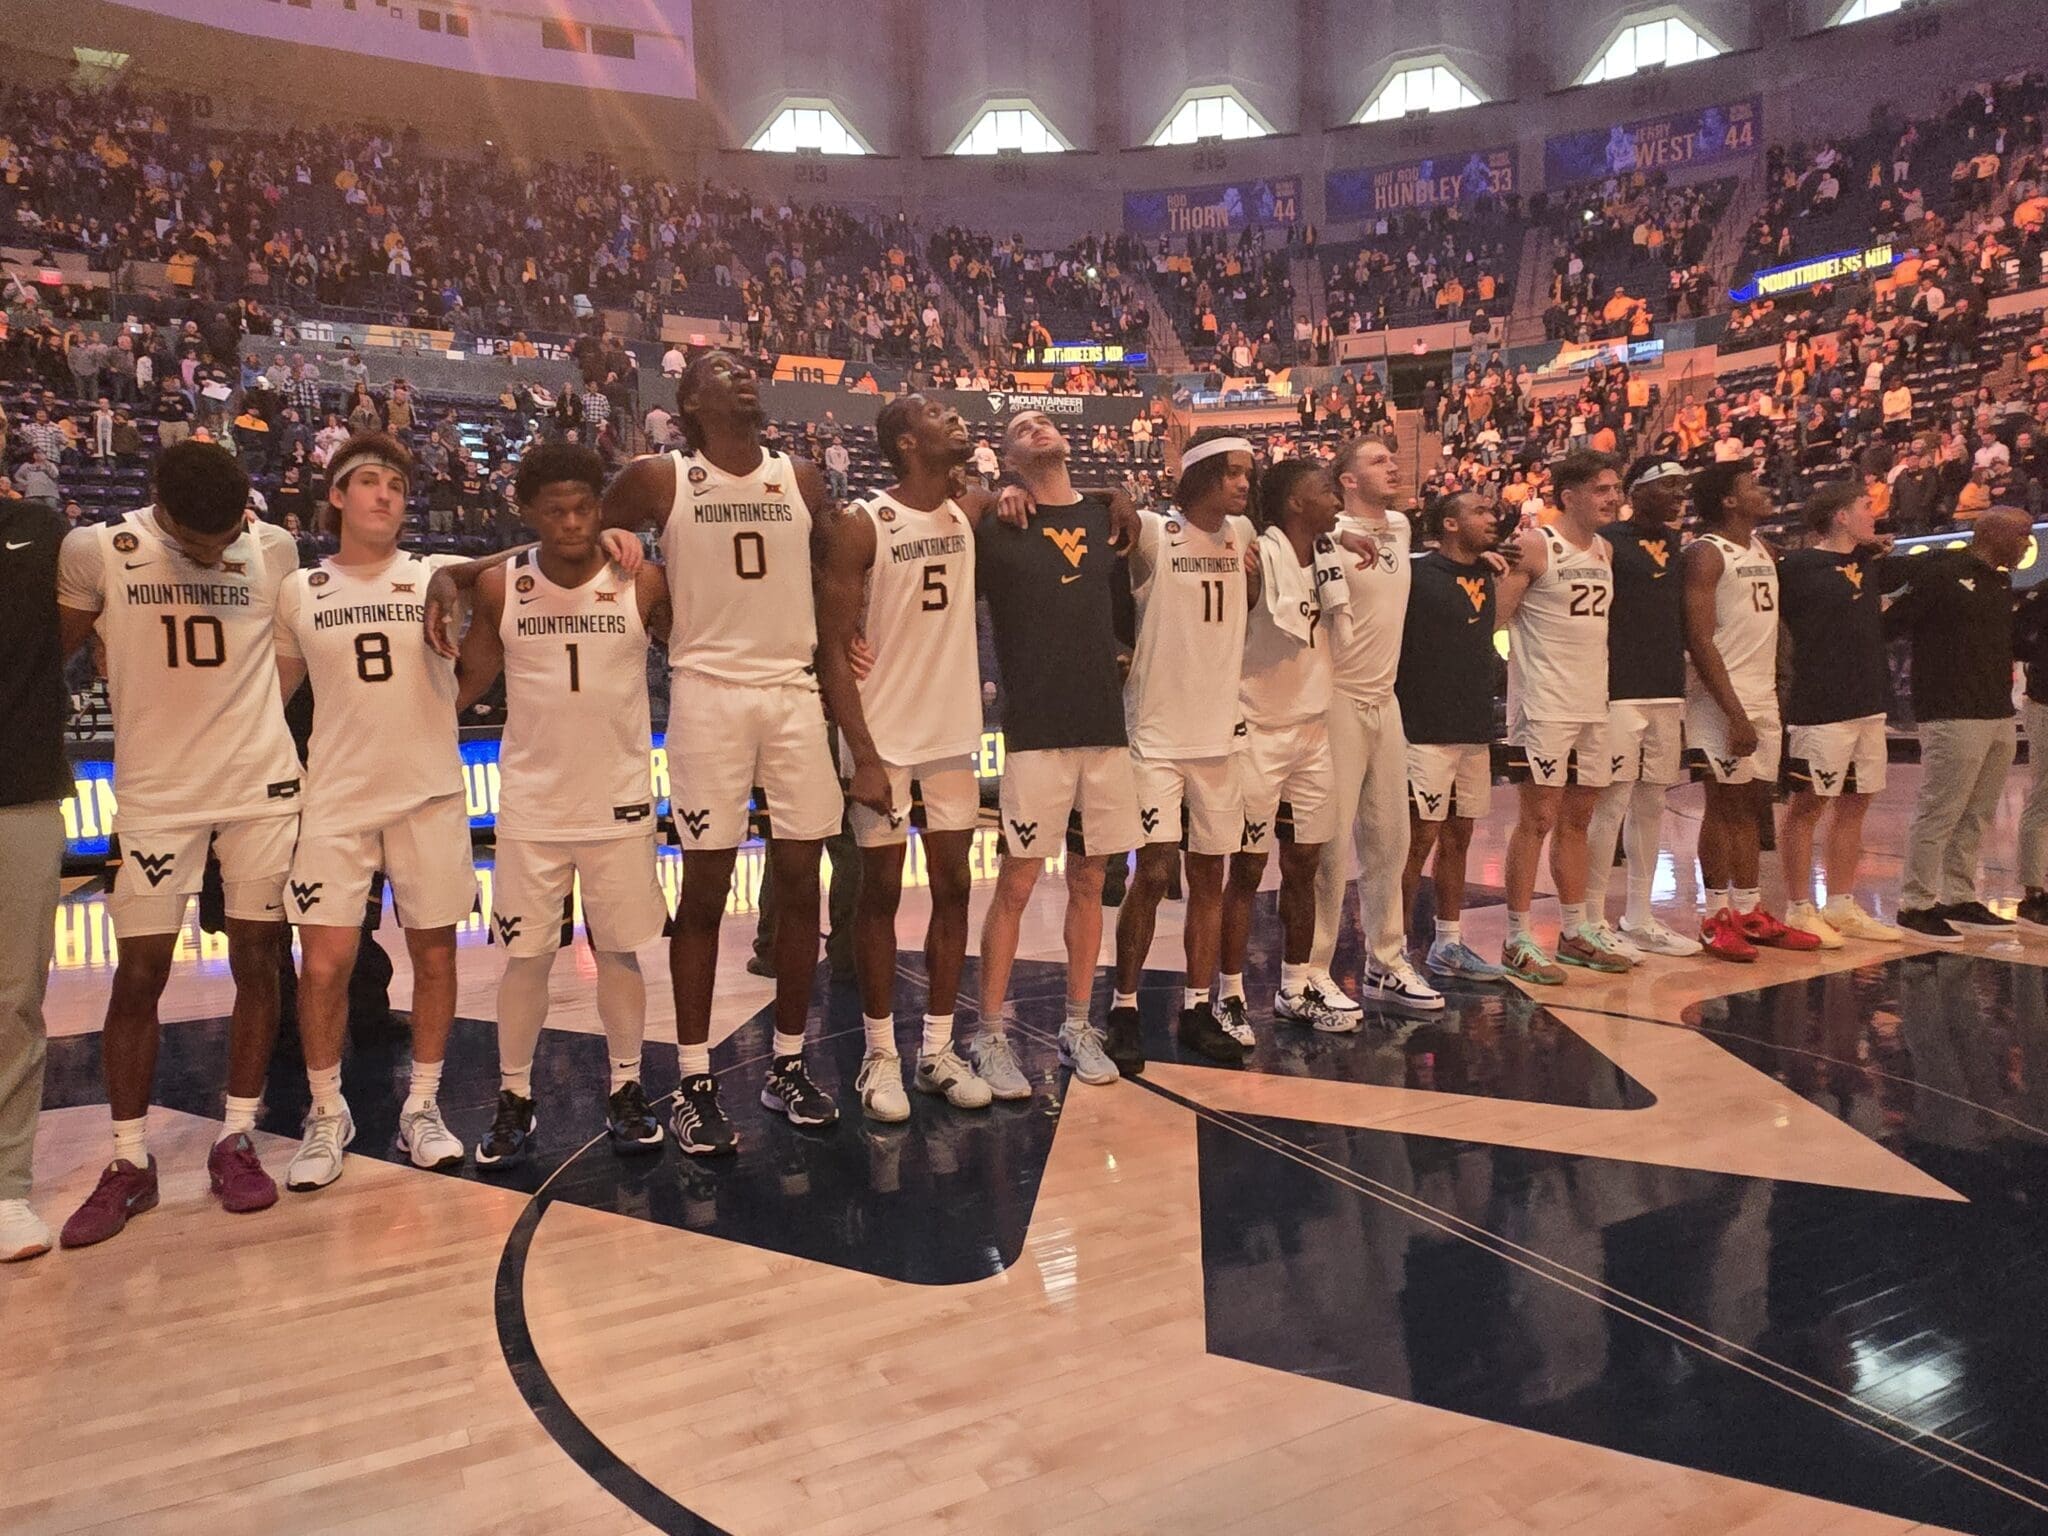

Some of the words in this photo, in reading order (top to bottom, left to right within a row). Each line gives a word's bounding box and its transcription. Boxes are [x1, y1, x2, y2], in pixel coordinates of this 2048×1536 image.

[1635, 122, 1671, 142] JERRY
[1725, 121, 1754, 149] 44
[1633, 132, 1696, 168] WEST
[1375, 170, 1392, 186] HOT
[1397, 166, 1419, 183] ROD
[1489, 167, 1512, 193] 33
[1167, 194, 1187, 208] ROD
[1375, 174, 1463, 209] HUNDLEY
[1168, 204, 1229, 232] THORN
[1273, 198, 1296, 222] 44
[793, 366, 825, 384] 109
[1008, 395, 1083, 406] MOUNTAINEER
[1057, 404, 1083, 415] CLUB
[694, 503, 792, 523] MOUNTAINEERS
[733, 531, 767, 580] 0
[891, 534, 966, 564] MOUNTAINEERS
[127, 583, 249, 606] MOUNTAINEERS
[922, 564, 948, 612] 5
[1201, 580, 1224, 622] 11
[1570, 584, 1607, 617] 22
[1751, 581, 1774, 612] 13
[314, 603, 424, 631] MOUNTAINEERS
[517, 615, 626, 637] MOUNTAINEERS
[160, 614, 226, 668] 10
[354, 631, 393, 683] 8
[565, 643, 580, 692] 1
